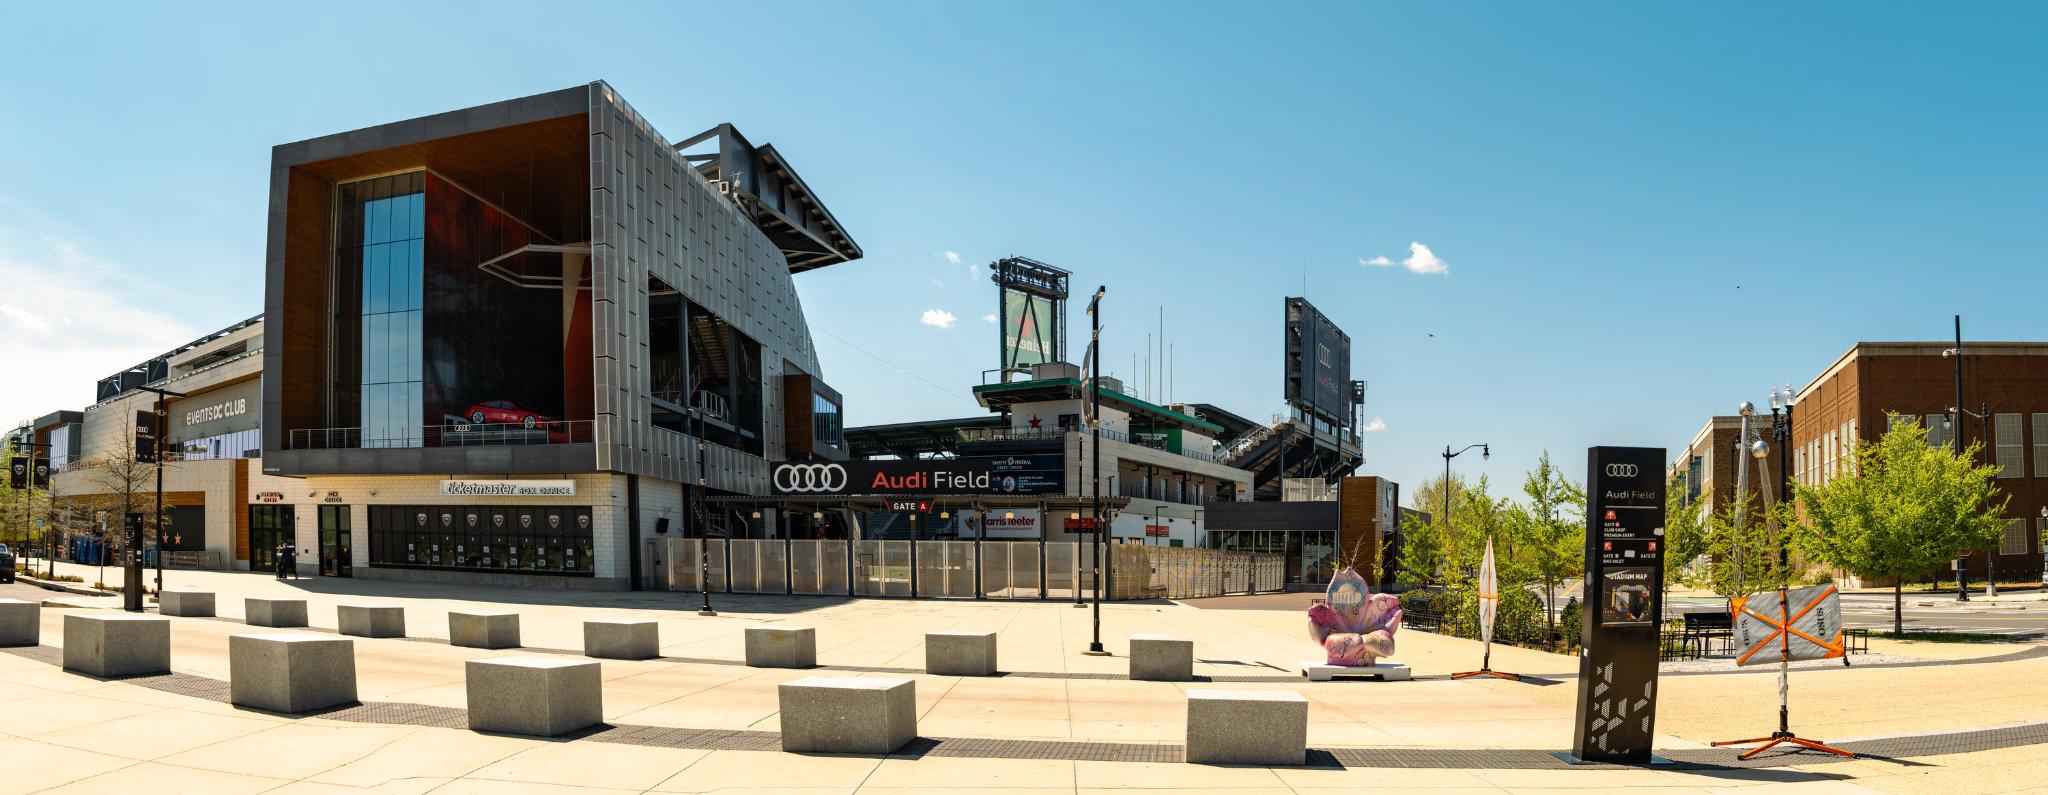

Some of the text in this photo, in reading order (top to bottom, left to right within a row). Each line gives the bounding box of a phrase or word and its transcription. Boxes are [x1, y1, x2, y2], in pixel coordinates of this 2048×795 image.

[224, 398, 246, 418] CLUB
[872, 471, 989, 489] Audi Field
[448, 482, 516, 495] ticketmaster
[1605, 490, 1655, 499] Audi Field
[893, 502, 926, 510] GATE A
[984, 516, 1007, 526] arris
